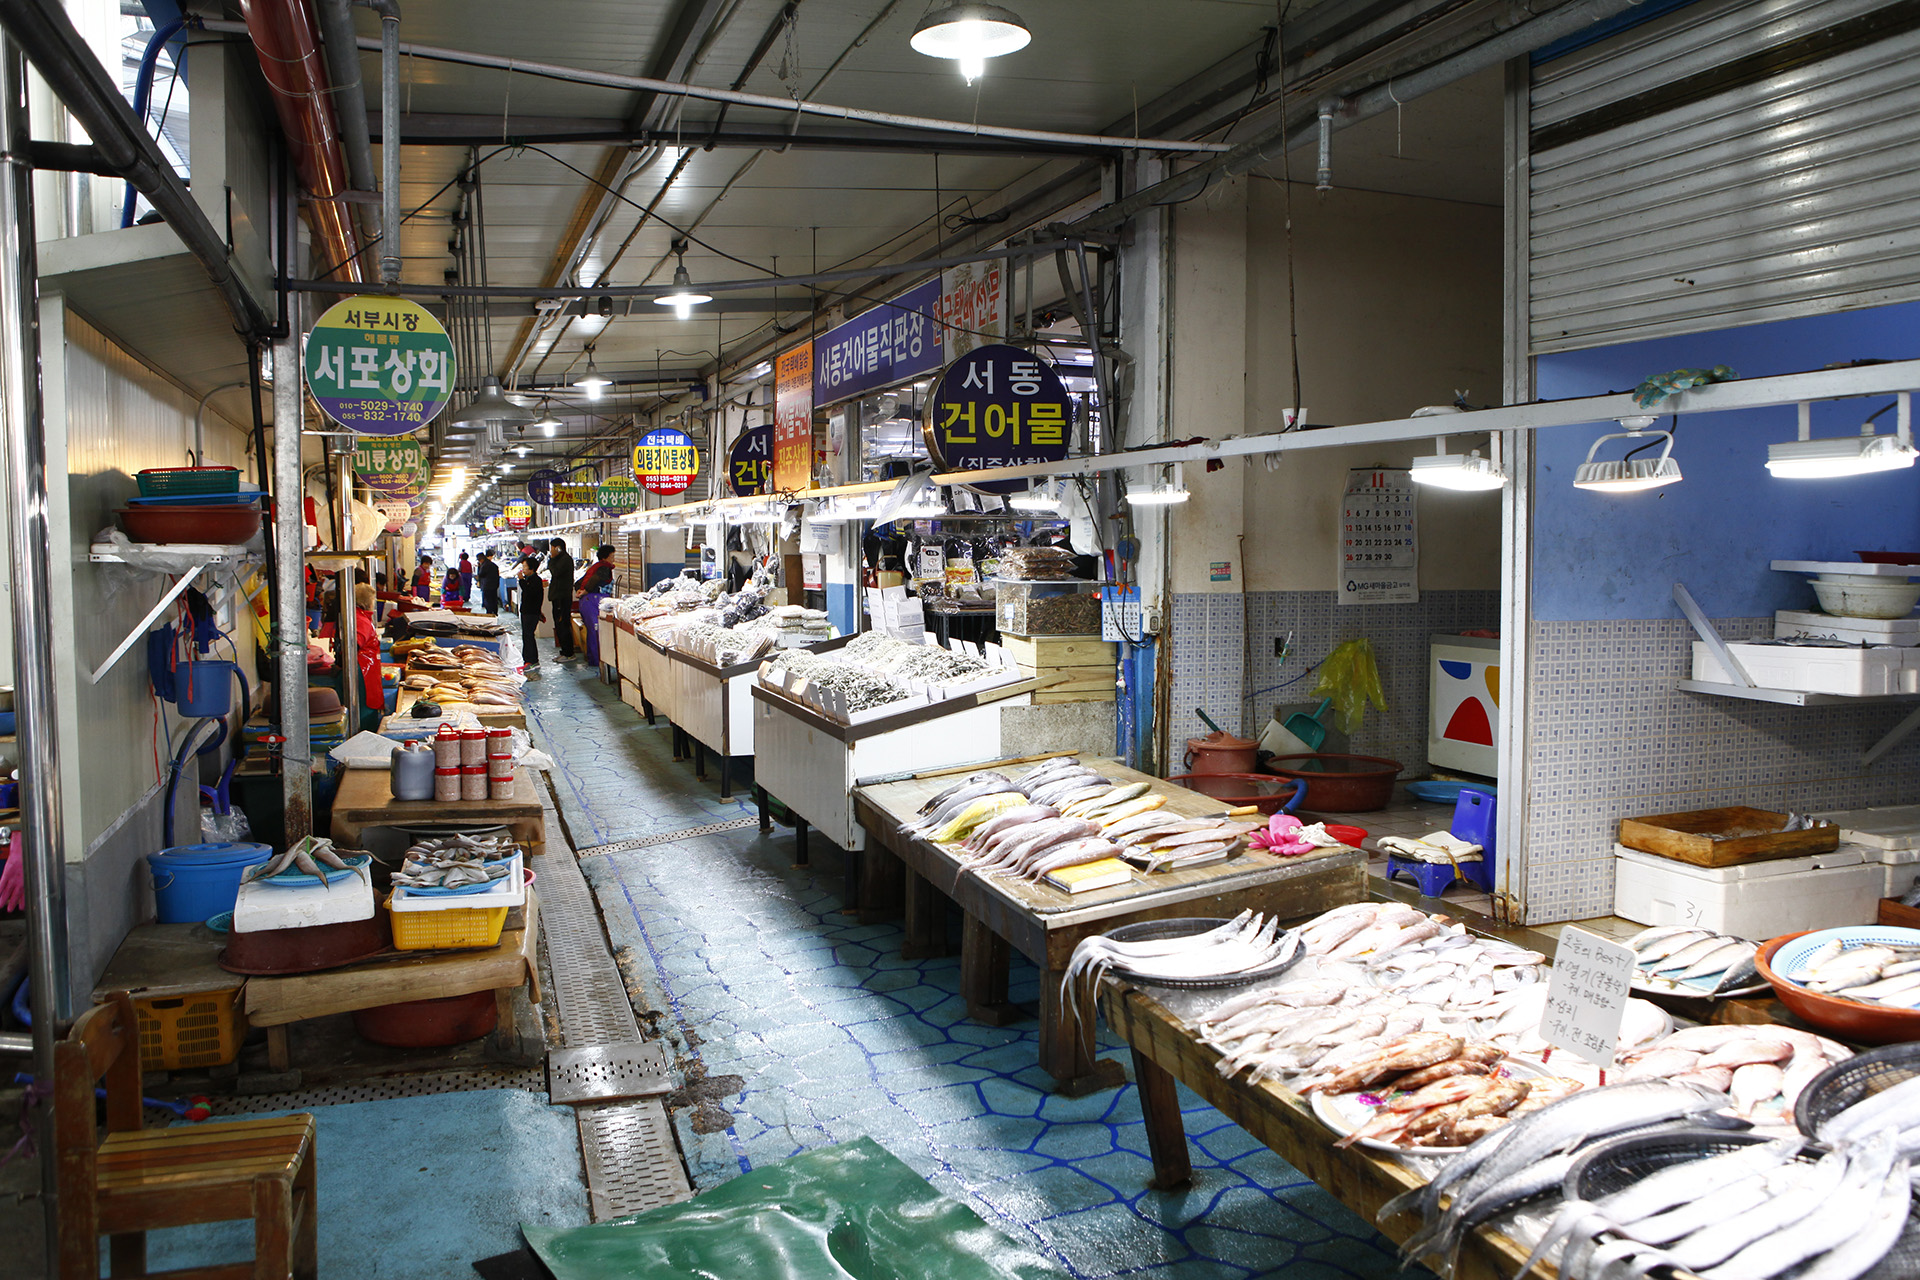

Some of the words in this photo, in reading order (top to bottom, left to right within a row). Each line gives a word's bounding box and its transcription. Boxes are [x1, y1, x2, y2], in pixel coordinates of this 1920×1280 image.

[345, 310, 419, 331] 서부시장
[819, 305, 925, 389] 서동건어물직판장
[315, 345, 447, 394] 서포상회
[961, 360, 1042, 395] 서동
[339, 401, 424, 412] 010-5029-1740
[342, 411, 421, 422] 055-832-1740
[940, 401, 1066, 445] 건어물
[647, 435, 685, 445] 전국택배
[356, 449, 419, 472] 미룡상회
[637, 449, 695, 470] 의령건어물상회
[778, 442, 808, 475] 진주상회
[1372, 472, 1384, 488] 11
[1345, 538, 1352, 546] 19
[1355, 538, 1362, 546] 20
[1365, 538, 1372, 546] 21
[1374, 538, 1382, 546] 22
[1384, 538, 1392, 546] 23
[1394, 538, 1402, 546] 24
[1404, 538, 1412, 546] 25
[1345, 553, 1353, 561] 26
[1355, 553, 1362, 561] 27
[1364, 553, 1372, 561] 28
[1374, 553, 1382, 561] 29
[1384, 553, 1392, 561] 30
[1685, 900, 1703, 927] 31
[1563, 933, 1591, 959] 오늘의
[1557, 1000, 1578, 1021] 삼치
